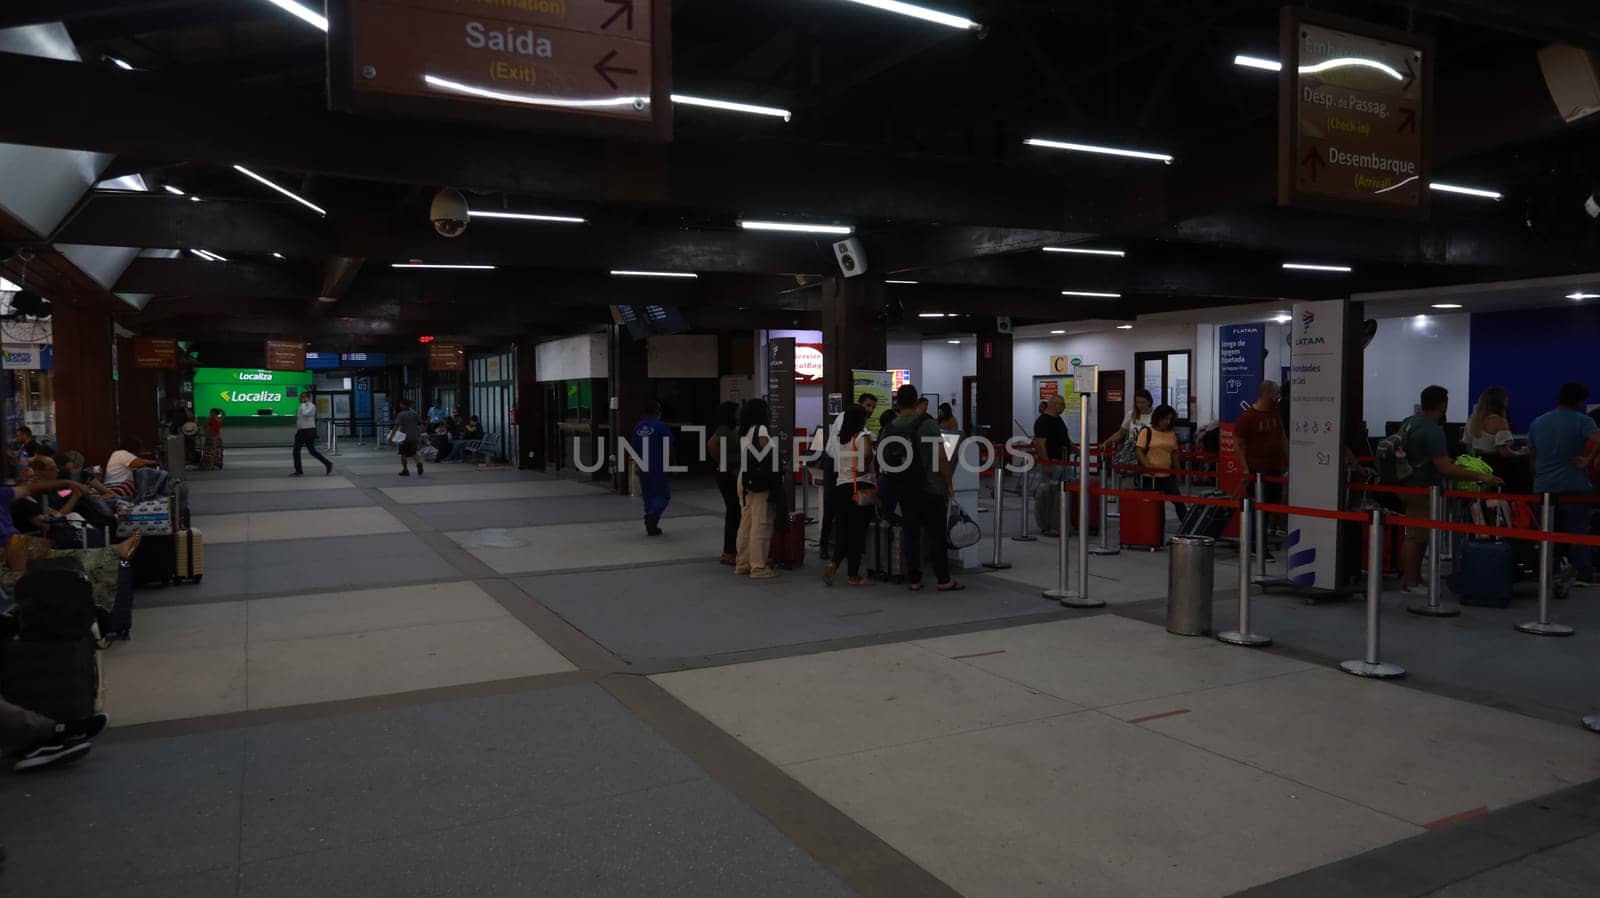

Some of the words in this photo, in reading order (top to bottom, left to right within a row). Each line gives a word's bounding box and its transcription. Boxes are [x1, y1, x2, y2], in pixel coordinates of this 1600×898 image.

[464, 21, 553, 58] Saída
[489, 62, 537, 84] (Exit)
[1328, 147, 1416, 175] Desembarque
[1295, 336, 1325, 346] LATAM
[1054, 357, 1064, 372] C
[239, 372, 273, 381] Localiza
[231, 390, 282, 402] Localiza
